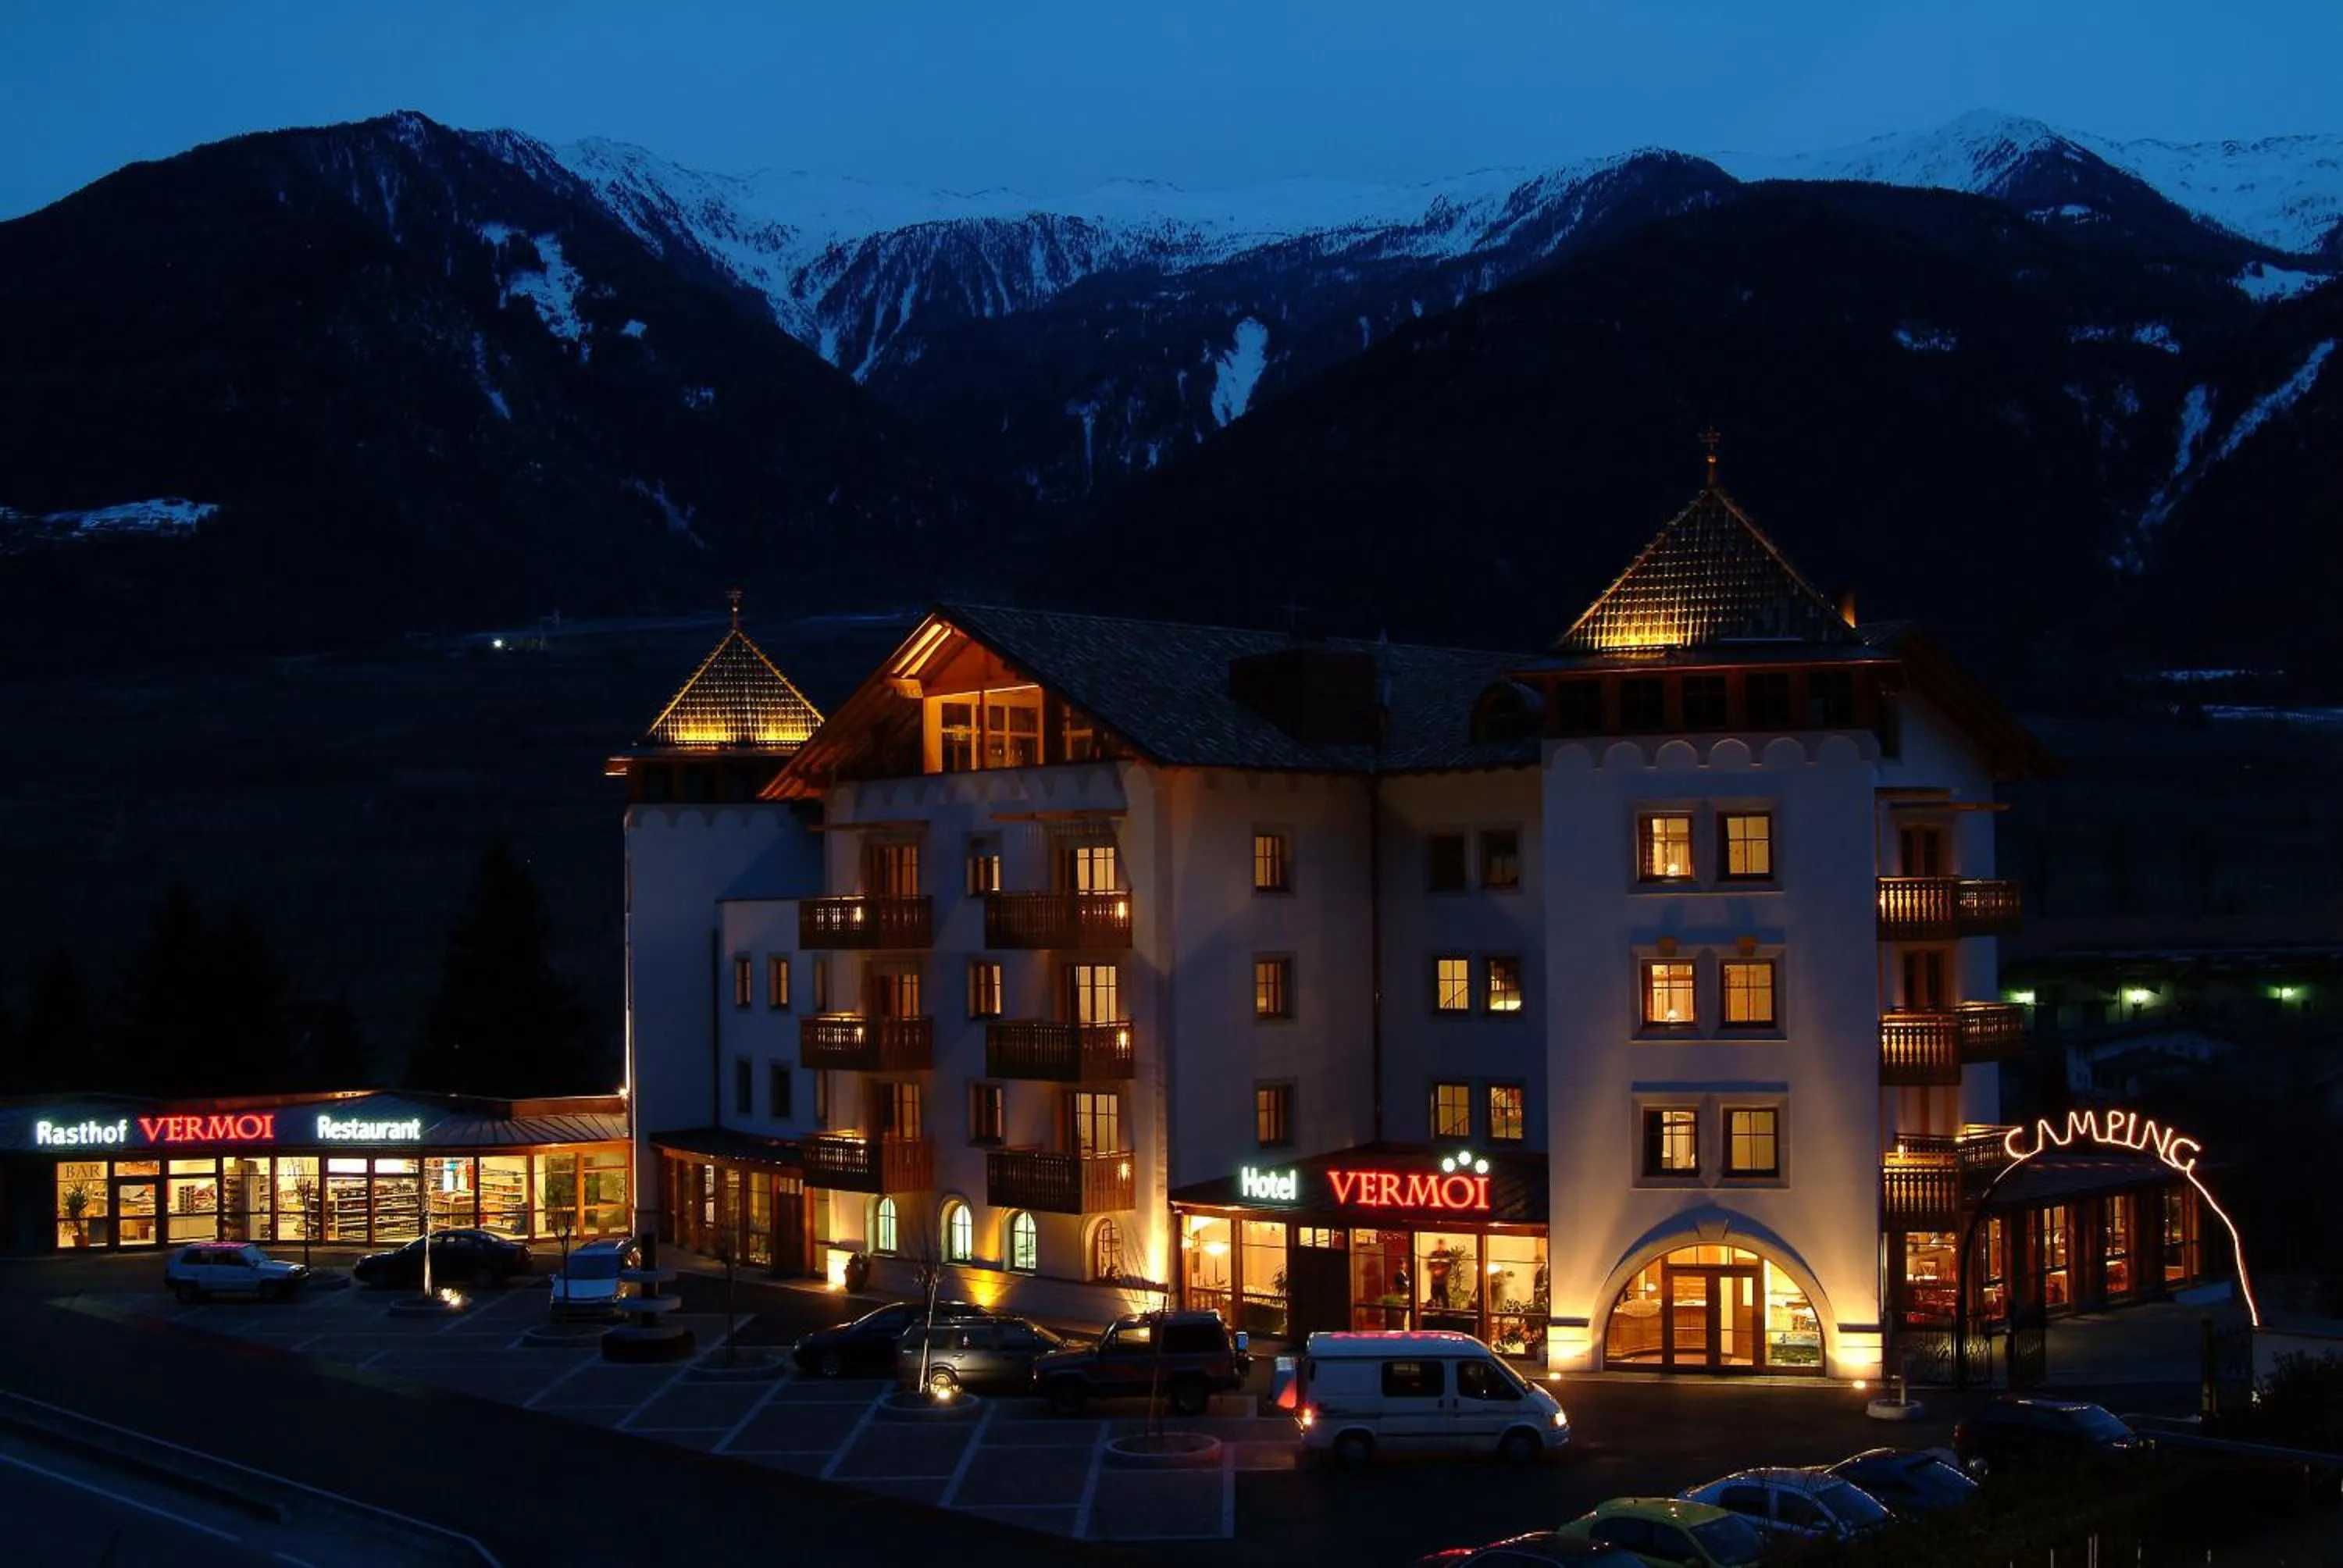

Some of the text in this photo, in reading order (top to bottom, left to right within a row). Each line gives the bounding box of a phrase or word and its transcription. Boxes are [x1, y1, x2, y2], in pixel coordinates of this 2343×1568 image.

[36, 1115, 421, 1145] Rasthof VERMOI Restaurant
[2005, 1110, 2201, 1170] CAMPING
[65, 1164, 100, 1178] BAR
[1242, 1167, 1491, 1210] Hotel VERMOI
